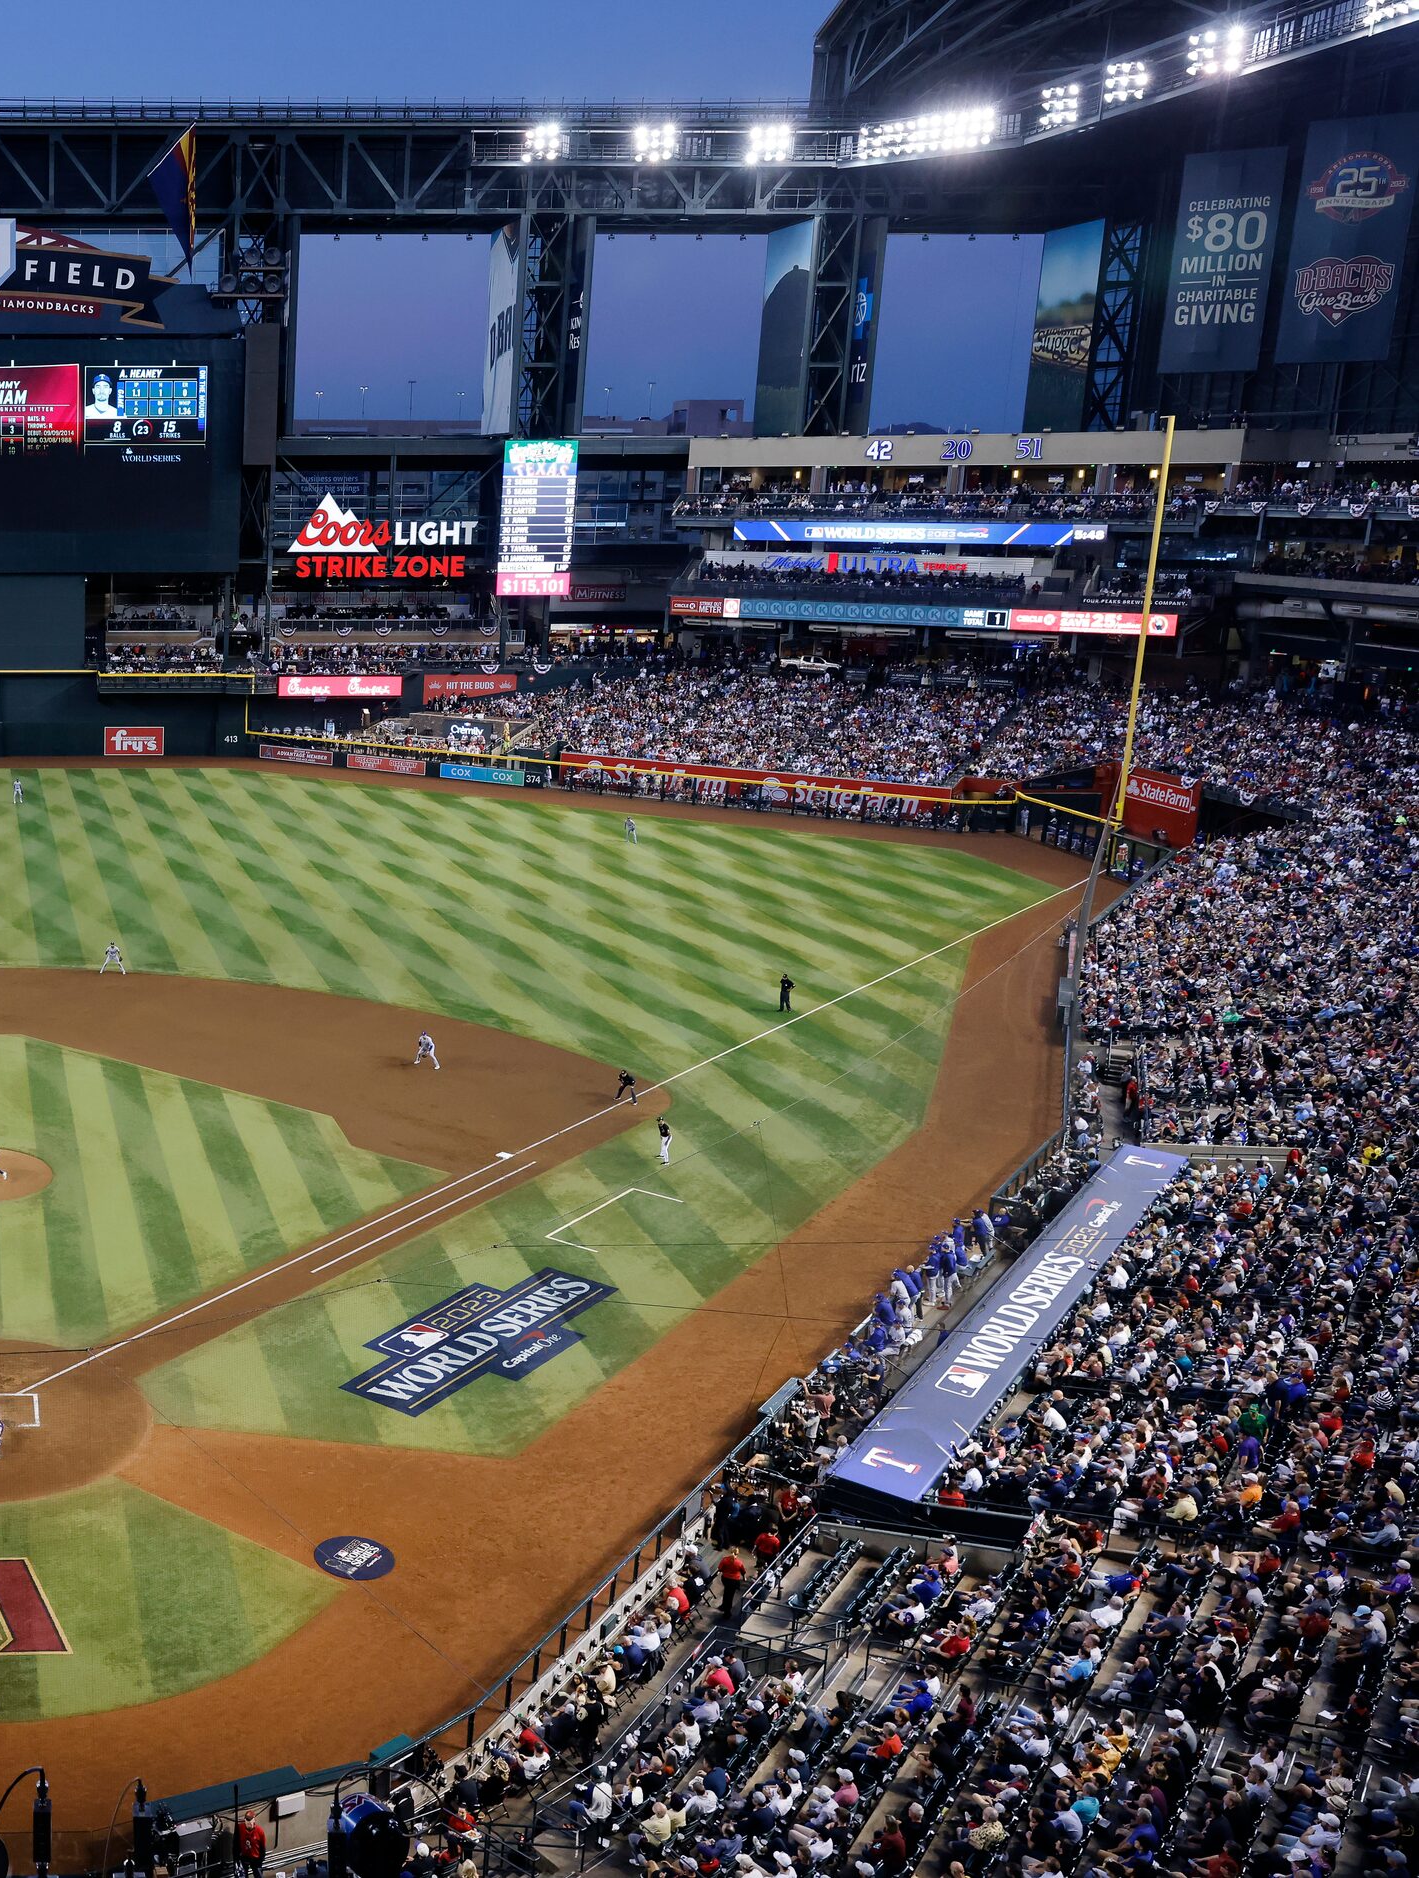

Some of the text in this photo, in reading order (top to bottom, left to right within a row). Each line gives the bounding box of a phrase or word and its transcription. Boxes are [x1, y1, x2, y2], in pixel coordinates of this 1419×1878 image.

[1189, 196, 1271, 212] CELEBRATING
[1318, 198, 1394, 207] ANNIVERSARY
[1186, 210, 1268, 253] $80
[1180, 253, 1263, 274] MILLION
[25, 260, 136, 290] FIELD
[1212, 275, 1226, 287] IN
[1177, 288, 1258, 303] CHARITABLE
[1302, 288, 1381, 311] Give Back
[1174, 302, 1255, 326] GIVING
[119, 369, 162, 378] A. HEANEY
[113, 421, 121, 432] 8
[137, 426, 149, 434] 23
[163, 421, 176, 432] 15
[866, 440, 893, 461] 42
[940, 439, 973, 460] 20
[1016, 438, 1043, 459] 51
[513, 464, 569, 476] TEXAS
[301, 484, 360, 492] taking big swings
[297, 509, 478, 546] Coors LIGHT
[823, 526, 956, 540] WORLD SERIES 2023
[1074, 529, 1107, 540] 5:48
[296, 556, 465, 578] STRIKE ZONE
[761, 555, 968, 574] Michelob ULTRA TERRACE
[502, 579, 564, 594] $115,101
[111, 729, 157, 752] fry's
[355, 756, 417, 768] DISCOUNT DISCOUNT
[451, 768, 513, 782] COX COX
[526, 775, 541, 784] 374
[956, 1226, 1100, 1371] WORLD SERIES 2023
[432, 1290, 501, 1330] 2023
[366, 1277, 590, 1402] WORLD SERIES
[341, 1542, 371, 1563] WORLD
[351, 1545, 380, 1567] SERIES
